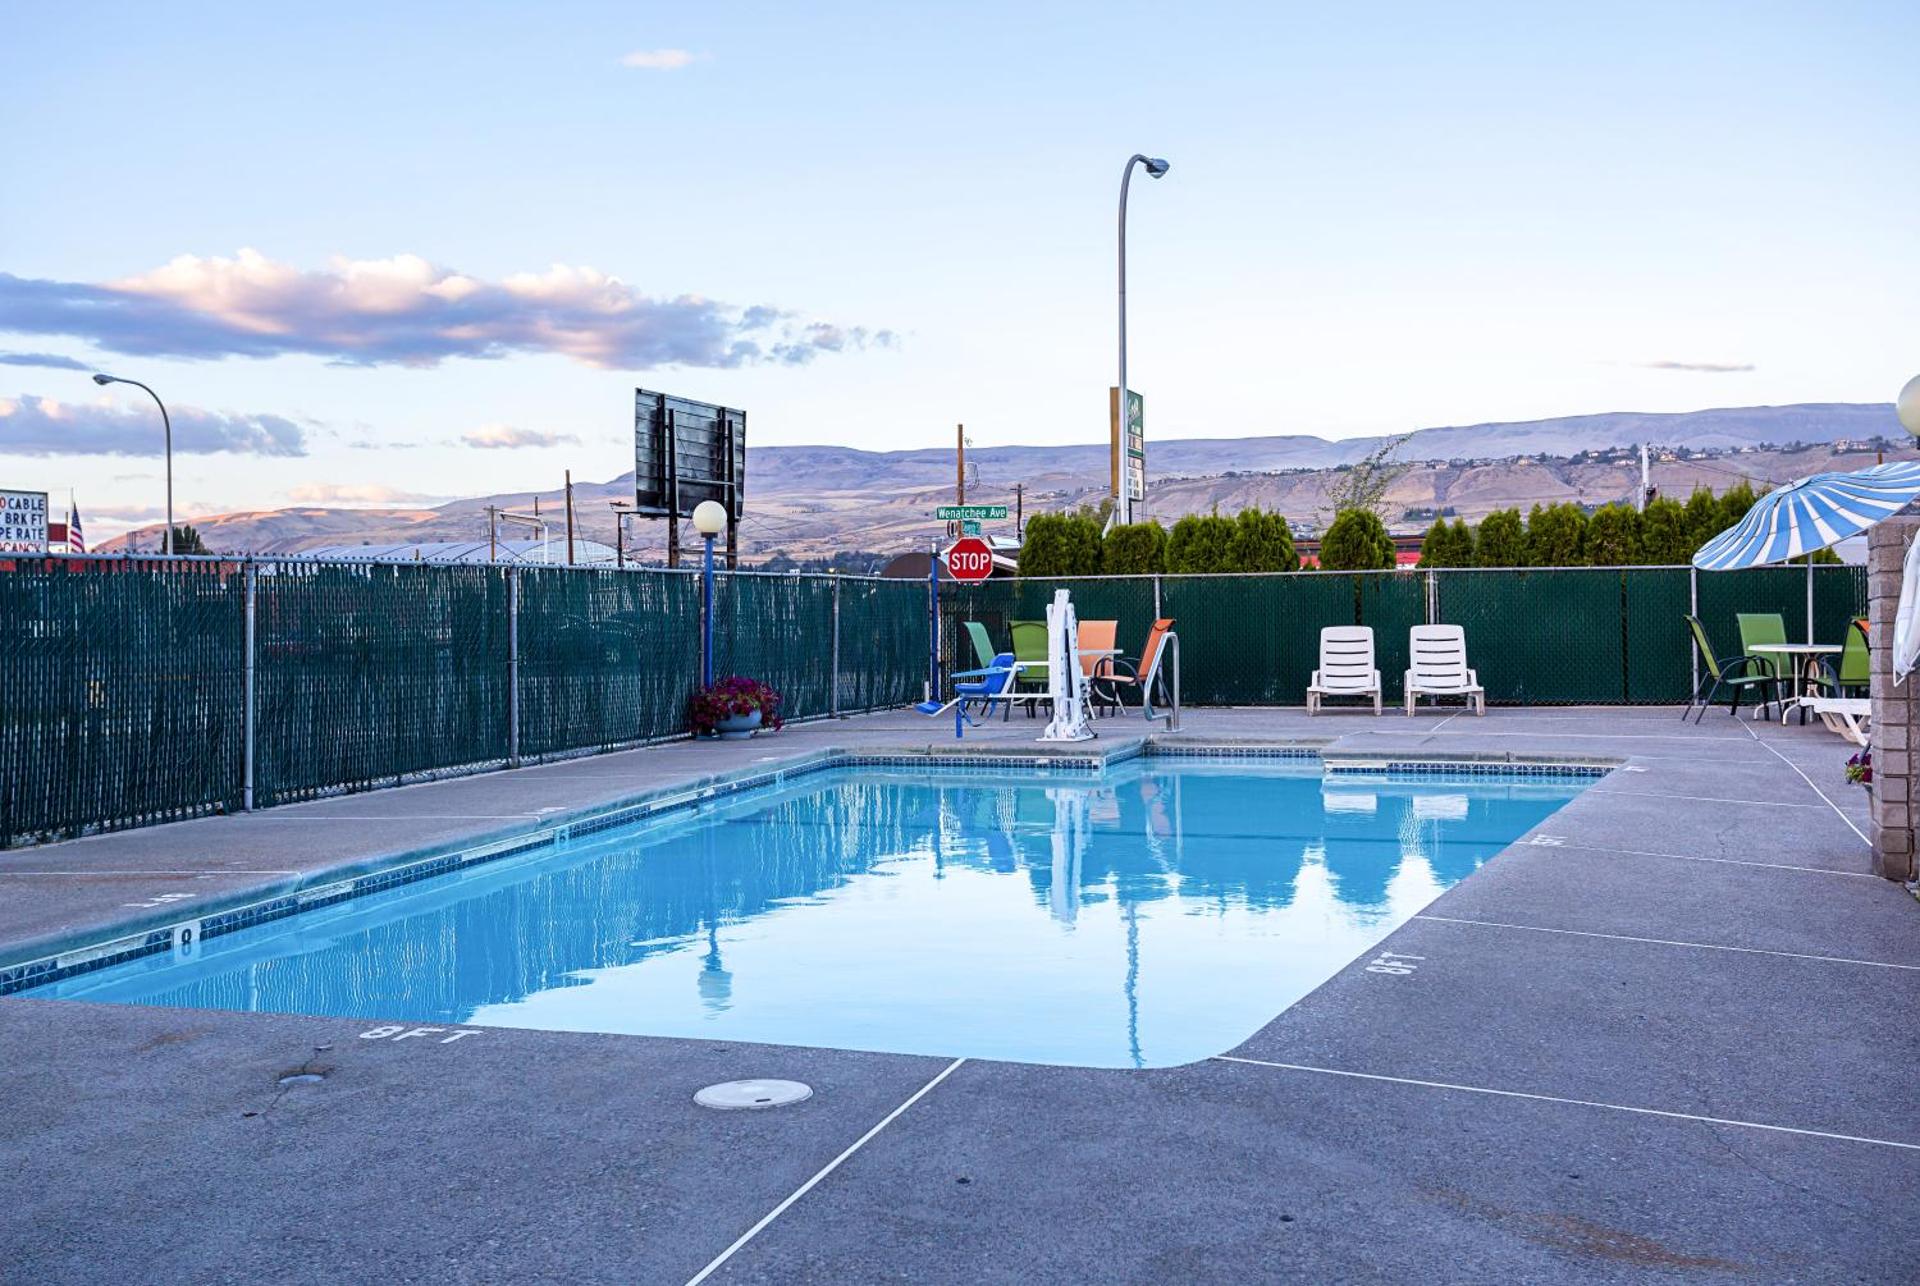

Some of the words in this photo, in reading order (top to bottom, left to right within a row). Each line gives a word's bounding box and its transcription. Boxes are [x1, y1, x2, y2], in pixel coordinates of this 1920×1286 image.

[8, 497, 44, 511] CABLE
[938, 508, 986, 519] Wenatchee
[990, 507, 1006, 517] Ave
[16, 528, 44, 540] RATE
[951, 553, 990, 570] STOP
[1365, 951, 1426, 975] 8FT
[359, 1025, 484, 1044] 8FT
